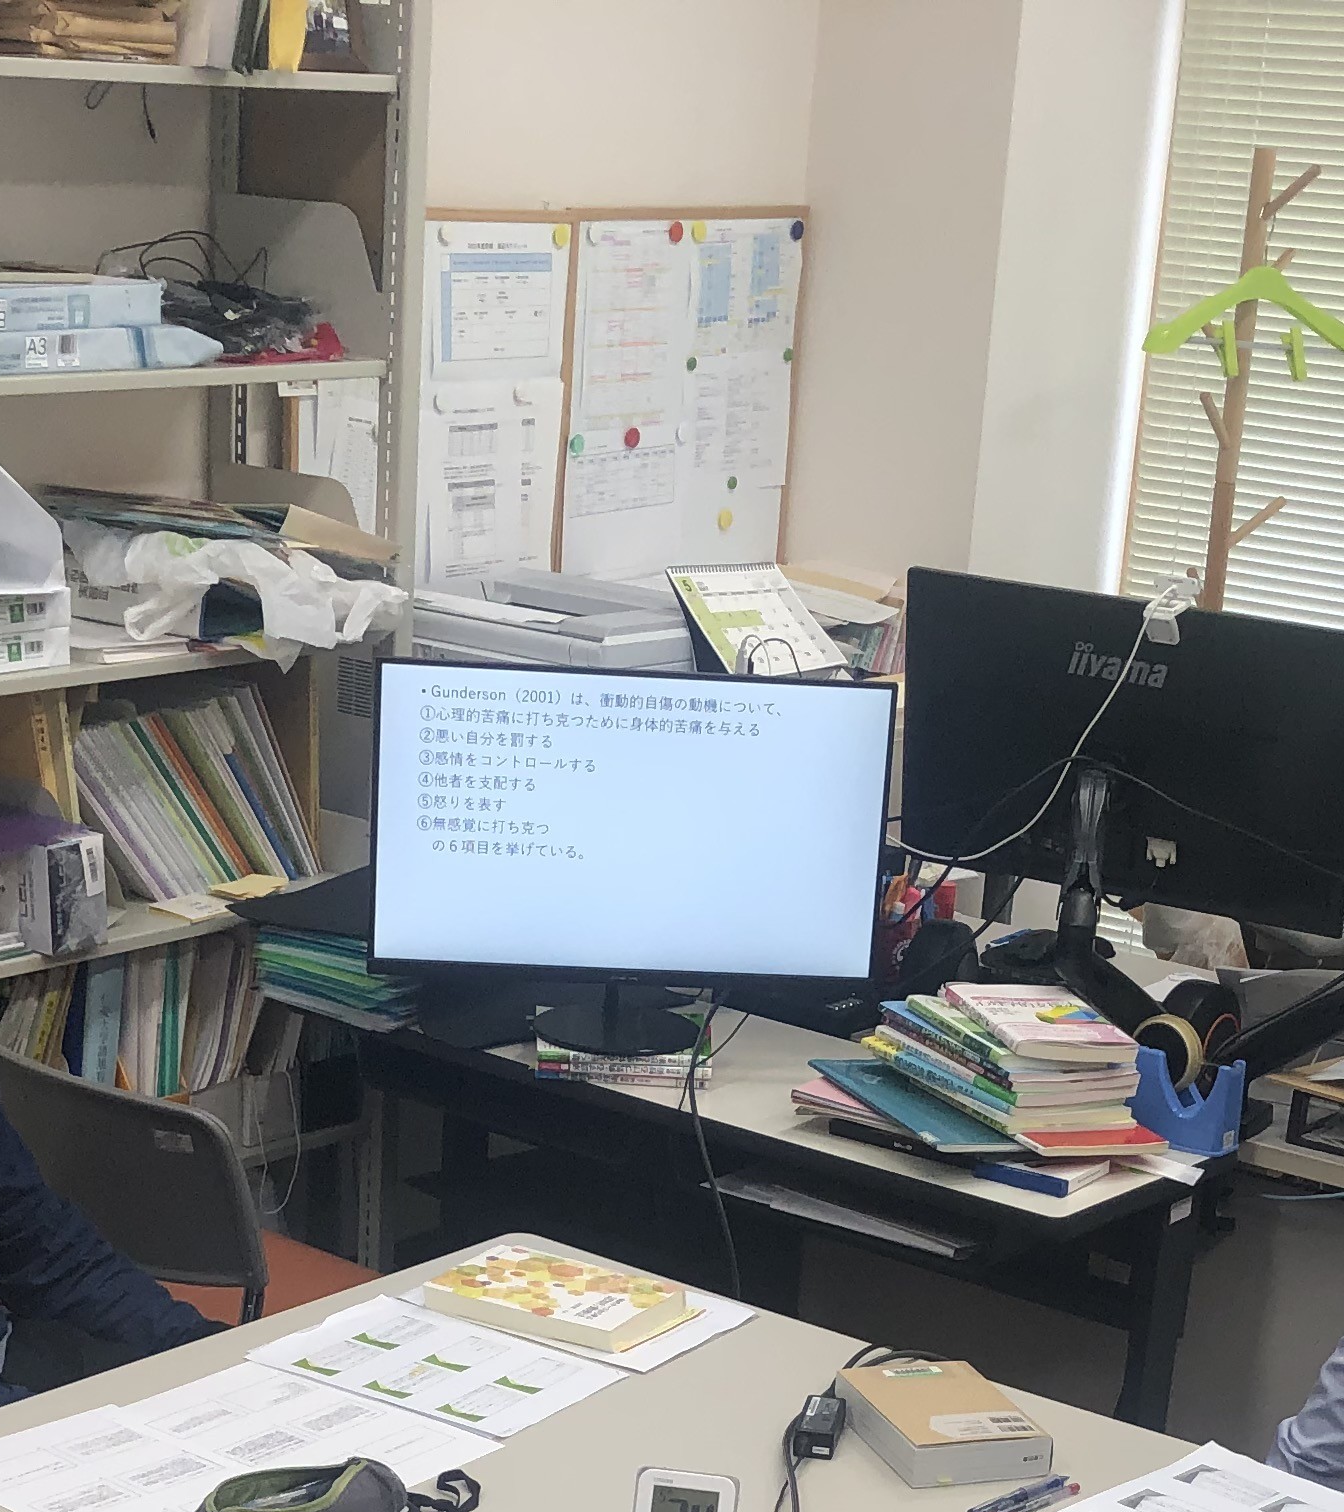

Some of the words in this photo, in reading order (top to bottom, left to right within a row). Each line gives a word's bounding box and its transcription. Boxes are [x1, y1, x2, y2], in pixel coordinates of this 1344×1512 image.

[26, 338, 47, 355] A3
[682, 580, 692, 592] 5
[1067, 640, 1169, 690] iiyama
[419, 727, 553, 749] ②悪い自分を罰する
[418, 749, 597, 774] ③感情をコントロールする
[417, 771, 537, 792] ④他者を支配する
[417, 792, 507, 812] ⑤怒りを表す
[416, 814, 550, 836] ⑥無感覚に打ち克つ
